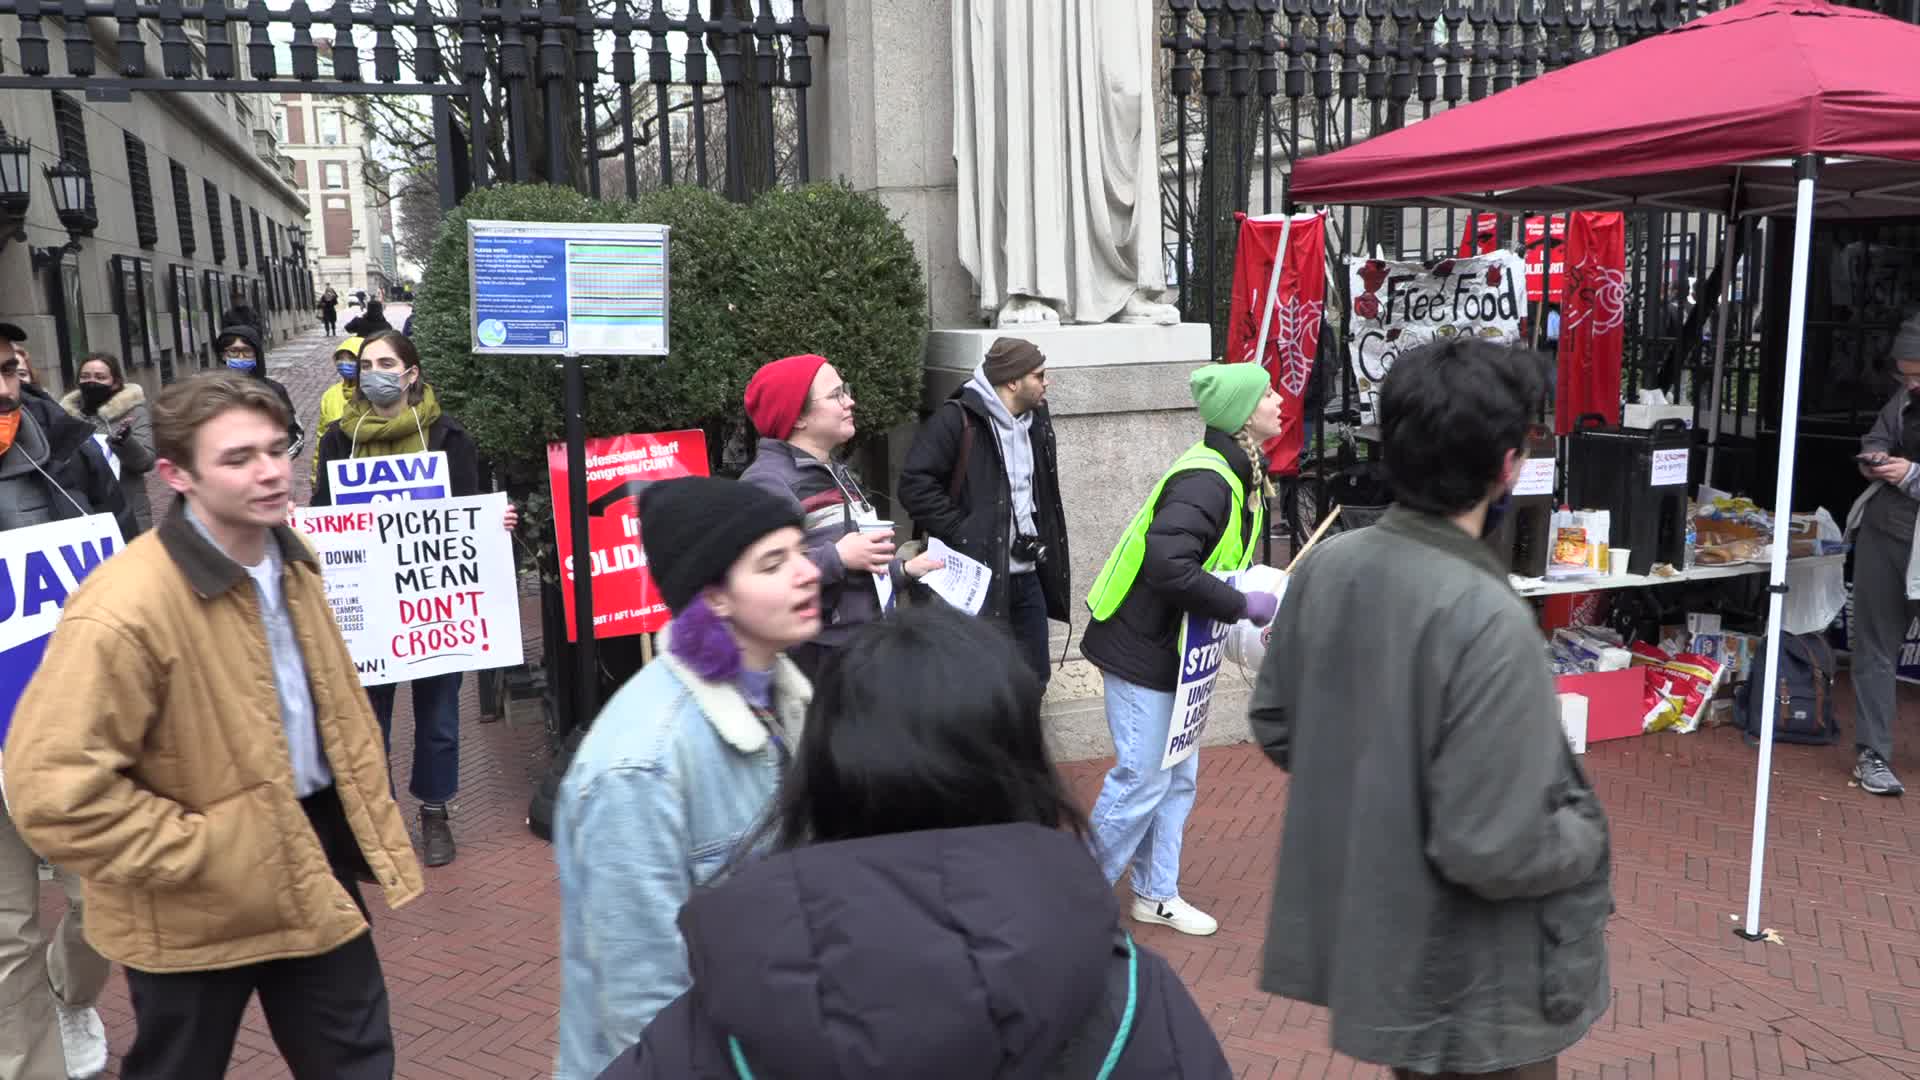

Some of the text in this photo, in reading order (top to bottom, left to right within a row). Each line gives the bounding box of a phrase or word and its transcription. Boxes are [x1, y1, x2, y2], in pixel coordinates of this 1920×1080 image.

[1385, 267, 1519, 324] Free Food
[586, 441, 679, 468] ofessional Staff
[338, 456, 438, 487] UAW
[304, 512, 373, 534] STRIKE!
[378, 507, 481, 544] PICKET
[325, 549, 367, 565] DOWN!
[397, 535, 477, 566] LINES
[395, 562, 479, 594] MEAN
[399, 591, 485, 625] DON'T
[338, 623, 364, 632] LASSES
[391, 618, 490, 658] CROSS!
[353, 658, 386, 678] WN!
[1185, 640, 1227, 676] STRI
[1187, 677, 1216, 707] UNFA
